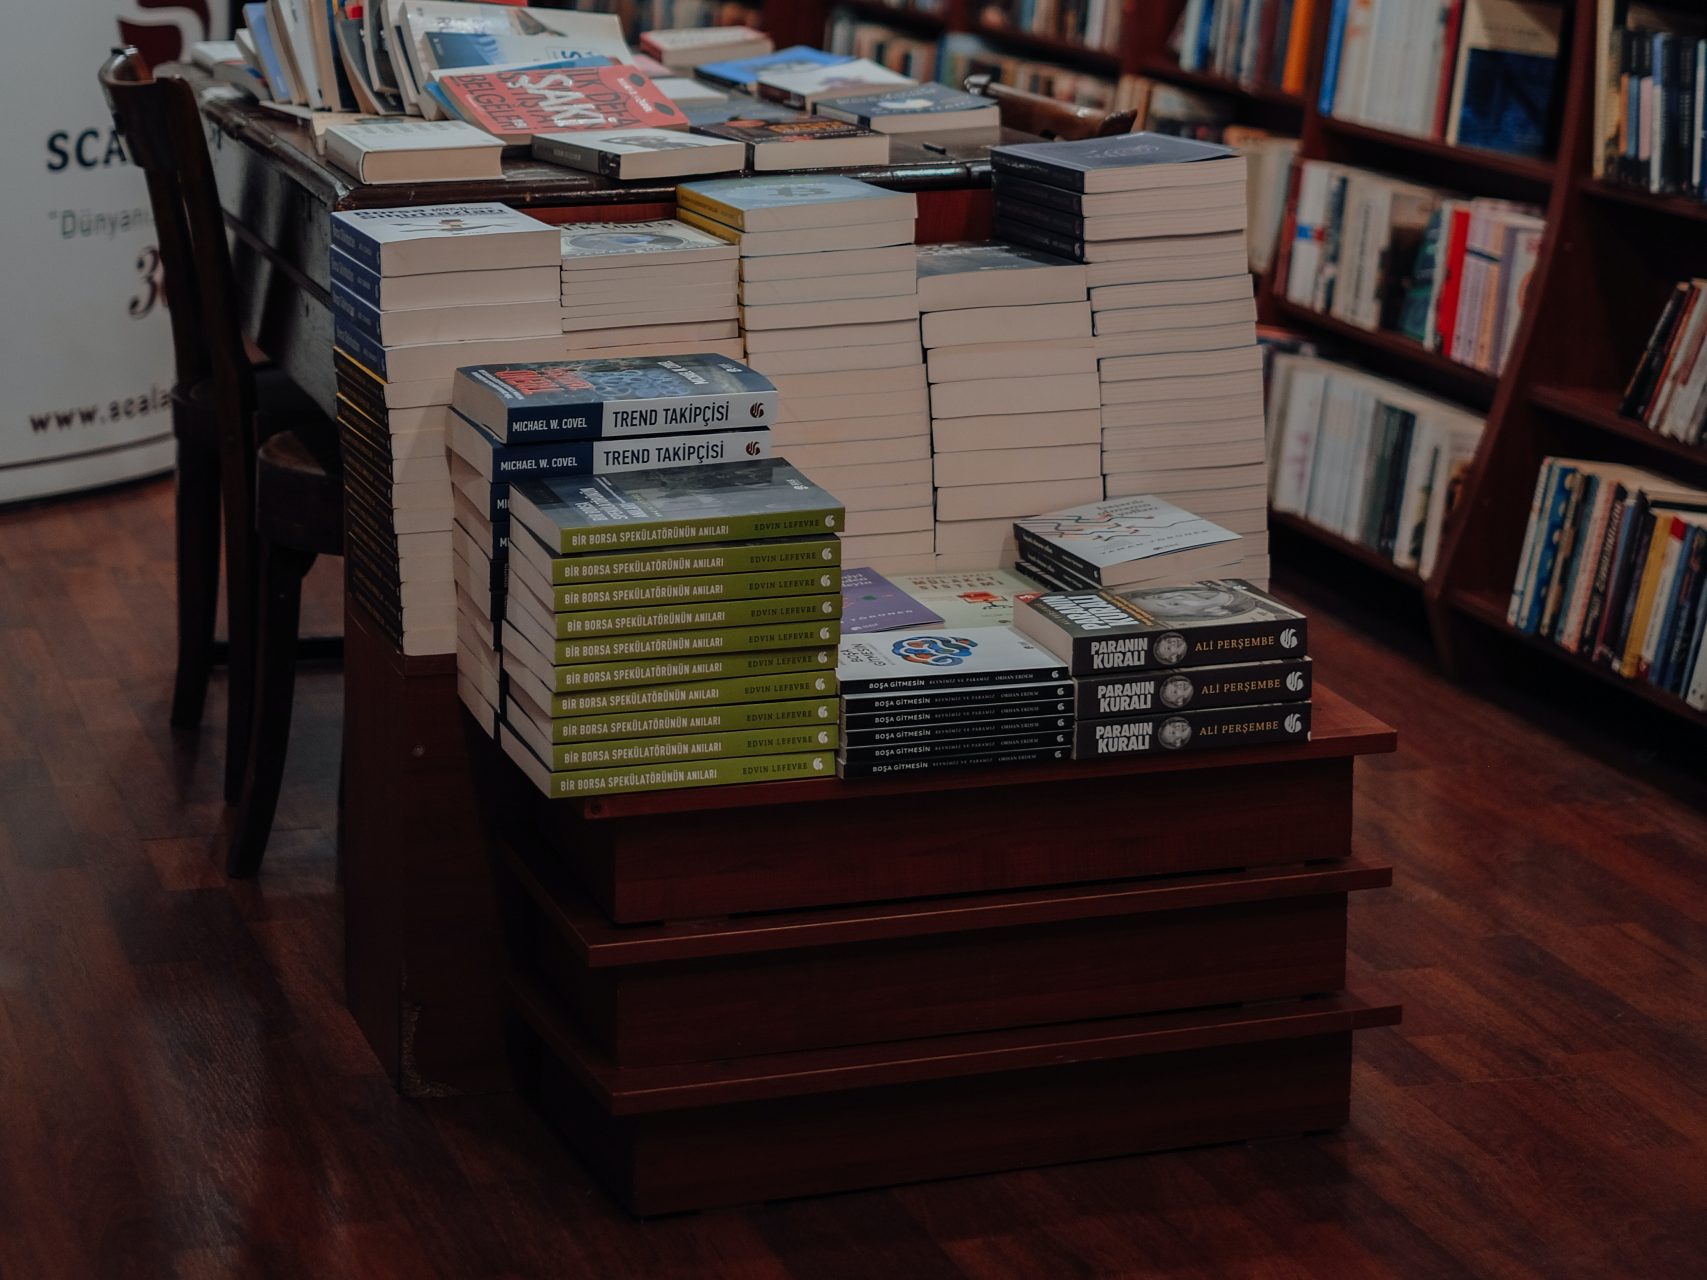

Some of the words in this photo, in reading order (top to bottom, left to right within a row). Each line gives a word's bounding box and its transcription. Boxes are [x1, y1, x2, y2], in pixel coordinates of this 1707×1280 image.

[613, 409, 657, 428] TREND
[663, 401, 729, 426] TAKİPÇİSİ
[513, 421, 547, 432] MICHAEL
[549, 420, 560, 430] W.
[562, 418, 587, 429] COVEL
[604, 448, 650, 466] TREND
[656, 440, 724, 464] TAKİPÇİSİ
[501, 461, 536, 471] MICHAEL
[538, 459, 550, 469] W.
[552, 457, 578, 467] COVEL
[783, 518, 819, 528] LEFEVRE
[572, 534, 586, 546] BİR
[589, 533, 617, 545] BORSA
[619, 525, 695, 542] SPEKÜLATÖRÜNÜN
[698, 524, 728, 536] ANILARI
[779, 550, 816, 560] LEFEVRE
[564, 565, 578, 577] BİR
[581, 564, 610, 576] BORSA
[612, 556, 690, 573] SPEKÜLATÖRÜNÜN
[693, 556, 723, 567] ANILARI
[778, 576, 815, 586] LEFEVRE
[564, 591, 578, 603] BİR
[581, 590, 610, 602] BORSA
[612, 582, 690, 600] SPEKÜLATÖRÜNÜN
[692, 582, 723, 594] ANILARI
[780, 603, 816, 613] LEFEVRE
[567, 618, 581, 631] BİR
[584, 617, 612, 630] BORSA
[615, 610, 692, 627] SPEKÜLATÖRÜNÜN
[694, 609, 724, 621] ANILARI
[778, 630, 814, 640] LEFEVRE
[565, 645, 579, 657] BİR
[582, 644, 610, 656] BORSA
[613, 636, 690, 653] SPEKÜLATÖRÜNÜN
[692, 636, 722, 647] ANILARI
[1091, 637, 1148, 655] PARANIN
[1195, 638, 1213, 651] ALİ
[1217, 636, 1275, 650] PERŞEMBE
[776, 655, 812, 665] LEFEVRE
[1093, 651, 1145, 670] KURALI
[566, 671, 580, 684] BİR
[583, 670, 611, 682] BORSA
[613, 662, 689, 680] SPEKÜLATÖRÜNÜN
[692, 661, 721, 673] ANILARI
[773, 681, 810, 692] LEFEVRE
[868, 681, 888, 690] BOŞA
[889, 678, 924, 687] GİTMESİN
[1097, 681, 1154, 699] PARANIN
[1201, 682, 1219, 695] ALİ
[1223, 678, 1281, 692] PERŞEMBE
[561, 697, 576, 709] BİR
[579, 696, 607, 708] BORSA
[609, 688, 686, 705] SPEKÜLATÖRÜNÜN
[688, 688, 718, 699] ANILARI
[874, 699, 894, 707] BOŞA
[895, 696, 930, 705] GİTMESİN
[1099, 694, 1151, 713] KURALI
[776, 709, 812, 719] LEFEVRE
[874, 715, 894, 724] BOŞA
[895, 712, 930, 721] GİTMESİN
[562, 724, 577, 736] BİR
[579, 723, 608, 735] BORSA
[610, 715, 687, 732] SPEKÜLATÖRÜNÜN
[690, 715, 720, 726] ANILARI
[1095, 722, 1152, 739] PARANIN
[1200, 724, 1217, 736] ALİ
[1222, 721, 1279, 734] PERŞEMBE
[776, 735, 812, 745] LEFEVRE
[875, 731, 894, 740] BOŞA
[896, 728, 930, 737] GİTMESİN
[564, 750, 578, 762] BİR
[581, 749, 609, 761] BORSA
[612, 741, 688, 759] SPEKÜLATÖRÜNÜN
[691, 741, 721, 753] ANILARI
[875, 748, 894, 757] BOŞA
[895, 744, 930, 754] GİTMESİN
[1098, 736, 1150, 753] KURALI
[771, 761, 807, 771] LEFEVRE
[872, 764, 891, 773] BOŞA
[893, 760, 927, 770] GİTMESİN
[560, 778, 574, 791] BİR
[577, 777, 605, 789] BORSA
[608, 768, 684, 786] SPEKÜLATÖRÜNÜN
[686, 768, 716, 780] ANILARI
